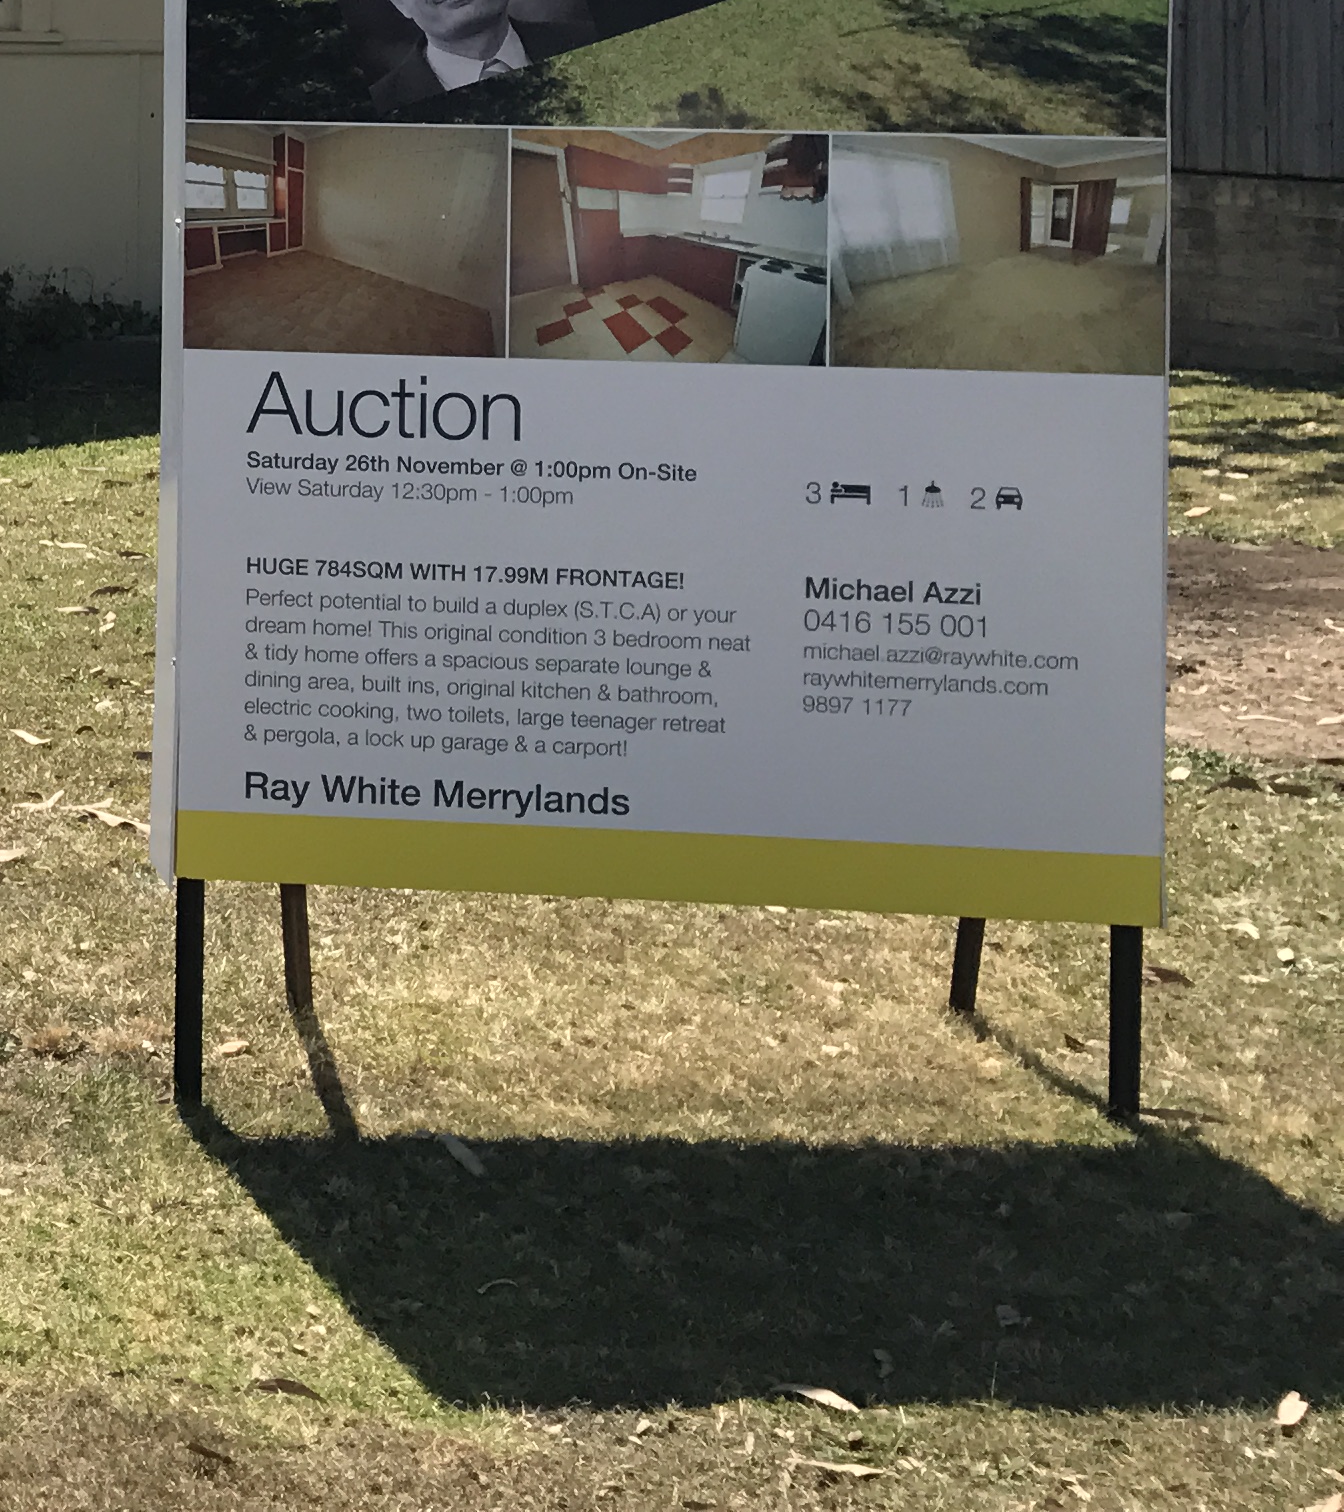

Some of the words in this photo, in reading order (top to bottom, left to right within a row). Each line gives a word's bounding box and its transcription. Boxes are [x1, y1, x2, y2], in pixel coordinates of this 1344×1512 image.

[246, 371, 521, 441] Auction
[247, 451, 339, 474] Saturday
[346, 455, 389, 472] 26th
[397, 456, 505, 475] November
[511, 459, 527, 476] @
[535, 461, 610, 482] 1:00pm
[618, 463, 696, 481] On-Site
[246, 477, 292, 495] View
[298, 479, 384, 502] Saturday
[392, 482, 476, 504] 12:30pm
[500, 486, 573, 507] 1:00pm
[806, 482, 821, 504] 3
[899, 485, 909, 506] 1
[971, 487, 985, 509] 2
[247, 557, 309, 576] HUGE
[315, 560, 402, 579] 784SQM
[410, 563, 465, 582] WITH
[474, 566, 548, 584] 17.99M
[556, 568, 683, 589] FRONTAGE!
[806, 577, 913, 603] Michael
[923, 581, 981, 605] Azzi
[247, 588, 313, 608] Perfect
[320, 593, 401, 612] potential
[407, 595, 426, 612] to
[433, 596, 478, 614] build
[485, 601, 497, 615] a
[503, 599, 568, 620] duplex
[575, 601, 660, 624] (S.T.C.A)
[668, 608, 688, 621] or
[693, 609, 737, 627] your
[804, 609, 871, 633] 0416
[883, 612, 930, 635] 155
[940, 614, 987, 638] 001
[246, 616, 306, 634] dream
[313, 618, 372, 637] home!
[378, 620, 418, 639] This
[424, 623, 492, 645] original
[499, 627, 587, 645] condition
[594, 629, 606, 646] 3
[613, 629, 701, 650] bedroom
[707, 635, 751, 652] neat
[245, 643, 258, 660] &
[264, 643, 298, 665] tidy
[304, 645, 359, 664] home
[365, 647, 418, 666] offers
[425, 653, 436, 667] a
[442, 653, 528, 672] spacious
[535, 657, 620, 676] separate
[627, 658, 692, 681] lounge
[698, 660, 712, 678] &
[804, 643, 1078, 670] michael.azzi@raywhite.com
[245, 670, 301, 693] dining
[308, 676, 354, 693] area,
[362, 675, 401, 693] built
[408, 676, 439, 697] ins,
[447, 679, 515, 700] original
[522, 681, 591, 701] kitchen
[597, 684, 611, 701] &
[618, 684, 717, 707] bathroom,
[804, 670, 1048, 695] raywhitemerrylands.com
[244, 697, 312, 716] electric
[318, 701, 399, 724] cooking,
[407, 704, 442, 722] two
[448, 706, 509, 727] toilets,
[517, 708, 564, 730] large
[571, 711, 657, 734] teenager
[663, 714, 725, 733] retreat
[803, 695, 853, 714] 9897
[863, 698, 912, 716] 1177
[244, 724, 257, 741] &
[264, 727, 340, 747] pergola,
[347, 732, 358, 745] a
[366, 729, 404, 748] lock
[411, 735, 435, 752] up
[442, 736, 508, 755] garage
[515, 735, 528, 753] &
[535, 740, 546, 753] a
[553, 740, 627, 759] carport!
[245, 771, 310, 808] Ray
[321, 774, 421, 806] White
[434, 779, 629, 818] Merrylands
